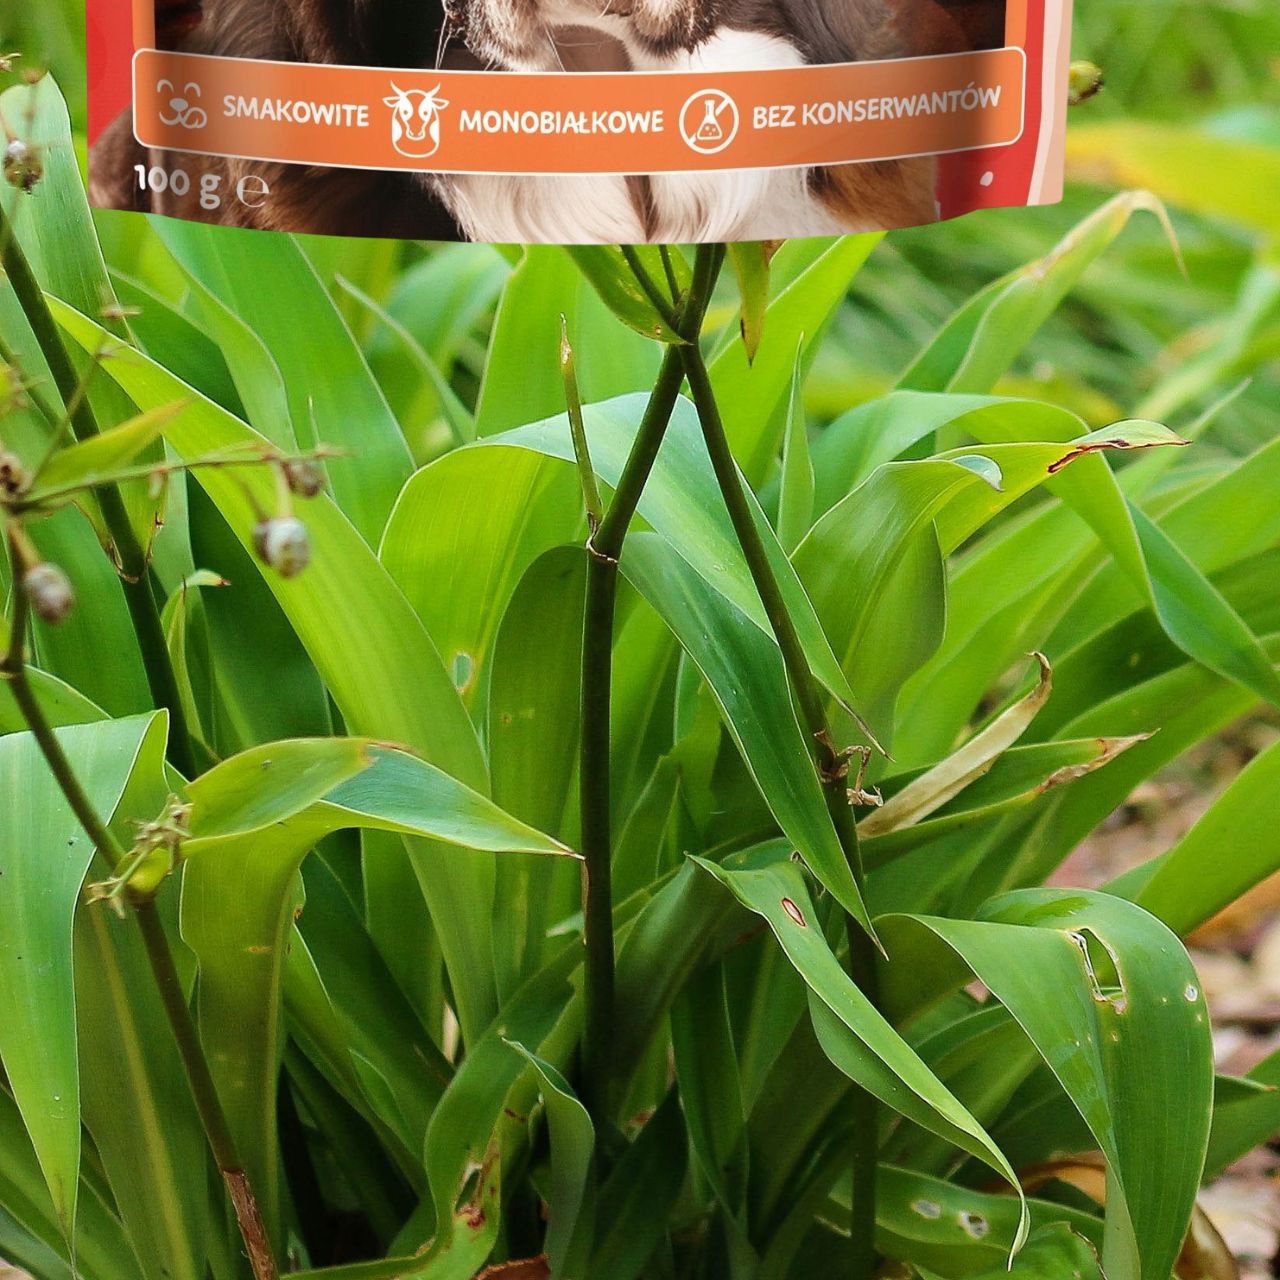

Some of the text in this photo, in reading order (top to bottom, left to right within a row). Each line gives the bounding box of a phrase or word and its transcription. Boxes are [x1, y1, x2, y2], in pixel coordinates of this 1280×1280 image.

[223, 95, 370, 128] SMAKOWITE
[459, 109, 664, 135] MONOBIAŁKOWE
[753, 81, 1002, 130] BEZ KONSERWANTÓW
[134, 164, 190, 196] 100
[199, 174, 222, 210] g
